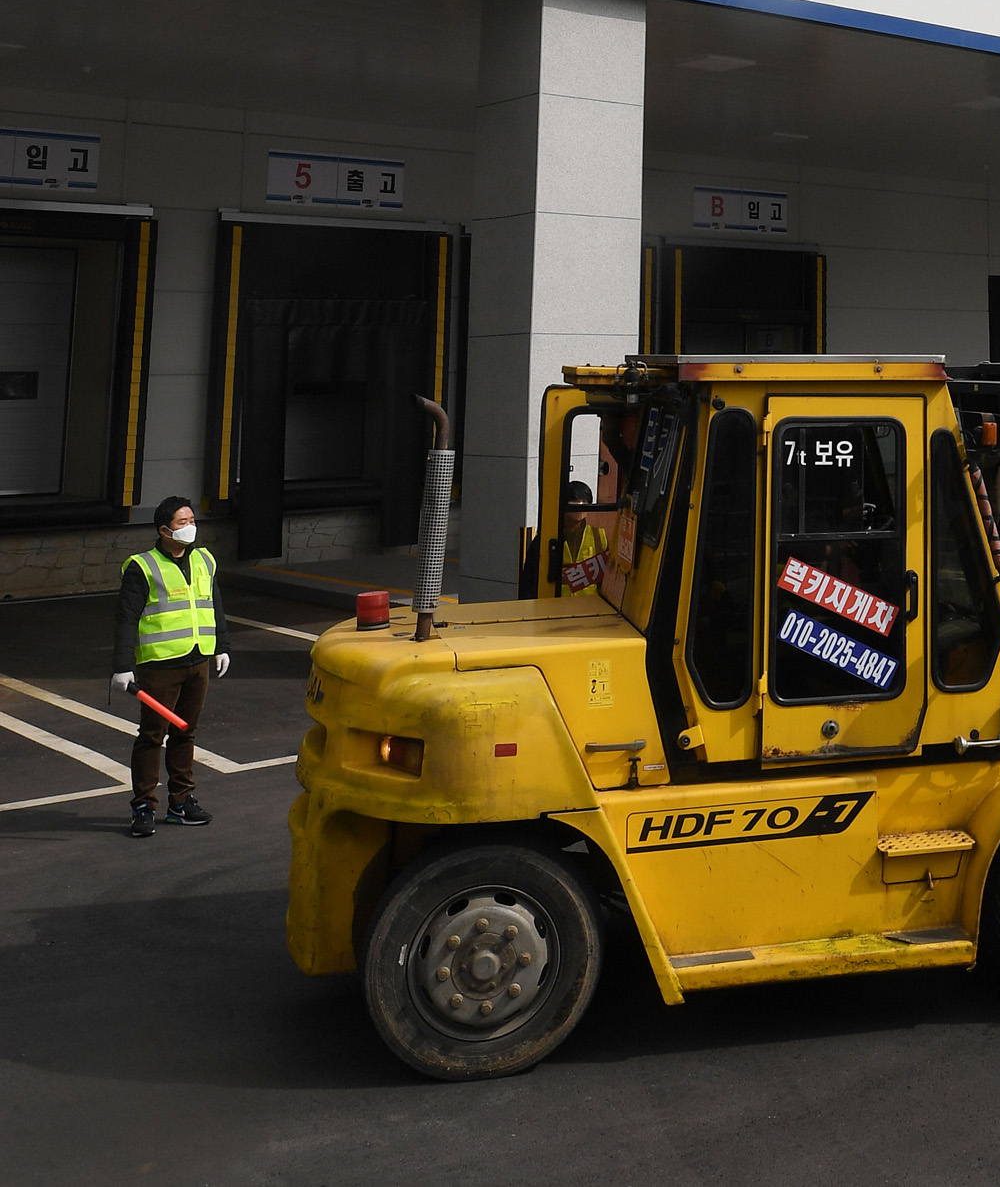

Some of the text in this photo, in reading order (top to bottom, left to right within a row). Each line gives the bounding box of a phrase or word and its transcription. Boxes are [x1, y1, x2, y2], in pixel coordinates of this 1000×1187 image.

[294, 163, 312, 189] 5
[711, 195, 724, 217] B
[814, 440, 854, 468] 보유
[785, 558, 896, 634] 럭키지게차
[780, 612, 896, 688] 010-2025-4847
[639, 809, 735, 842] HDF
